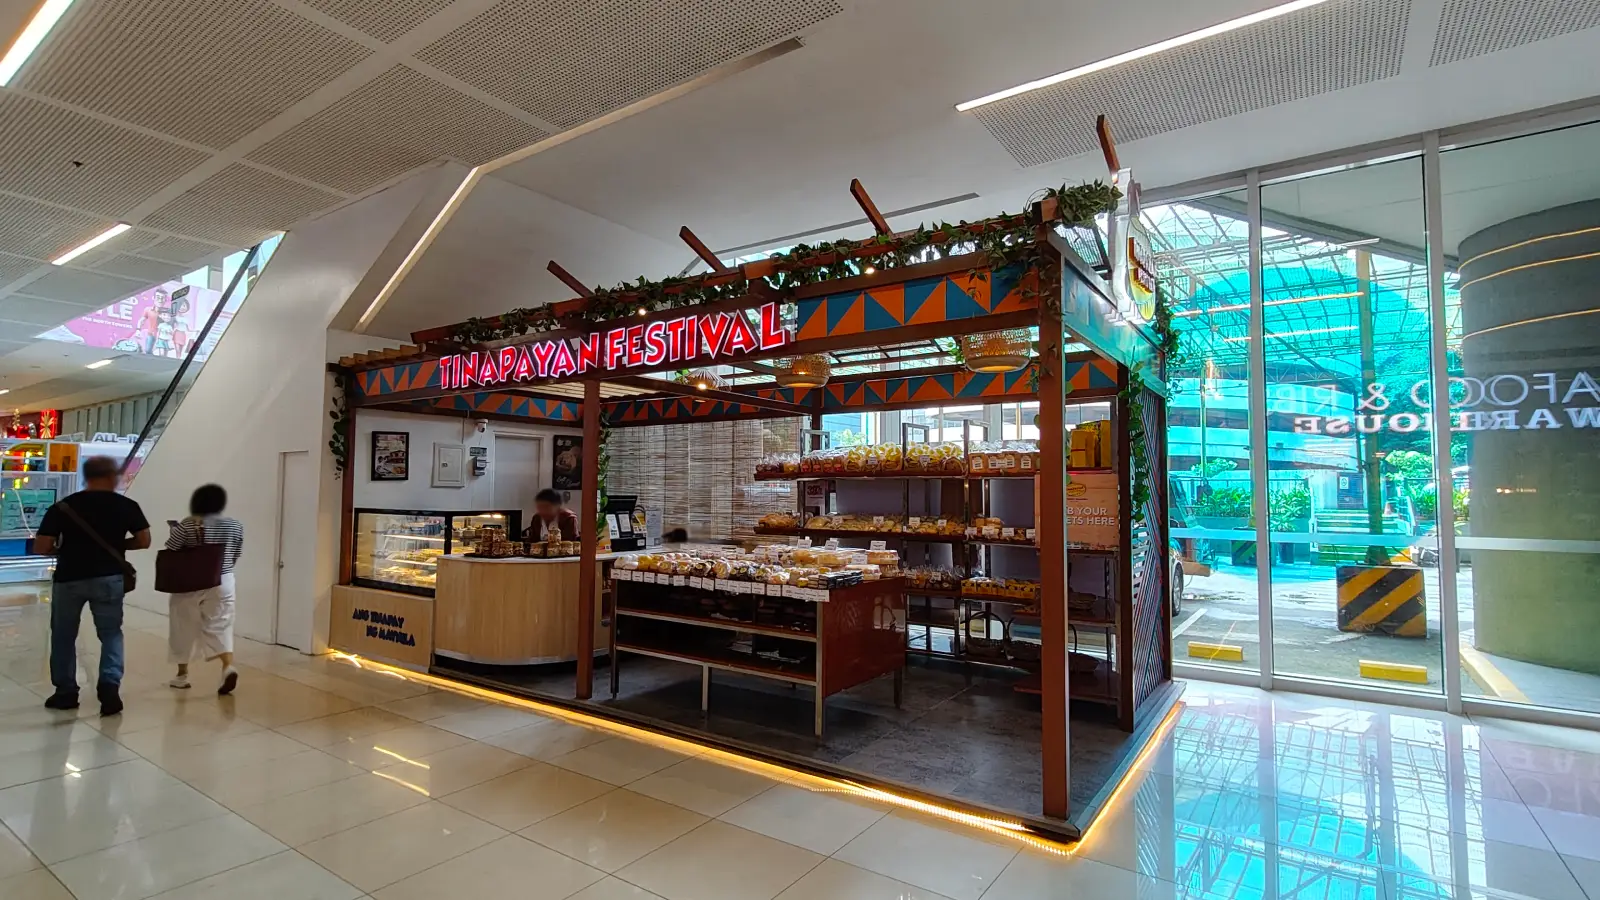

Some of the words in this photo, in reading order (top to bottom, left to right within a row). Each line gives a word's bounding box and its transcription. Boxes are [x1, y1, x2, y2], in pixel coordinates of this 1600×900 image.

[439, 332, 599, 390] TINAPAYAN
[607, 302, 785, 370] FESTIVAL
[1078, 507, 1107, 516] YOUR
[1086, 517, 1115, 526] HERE
